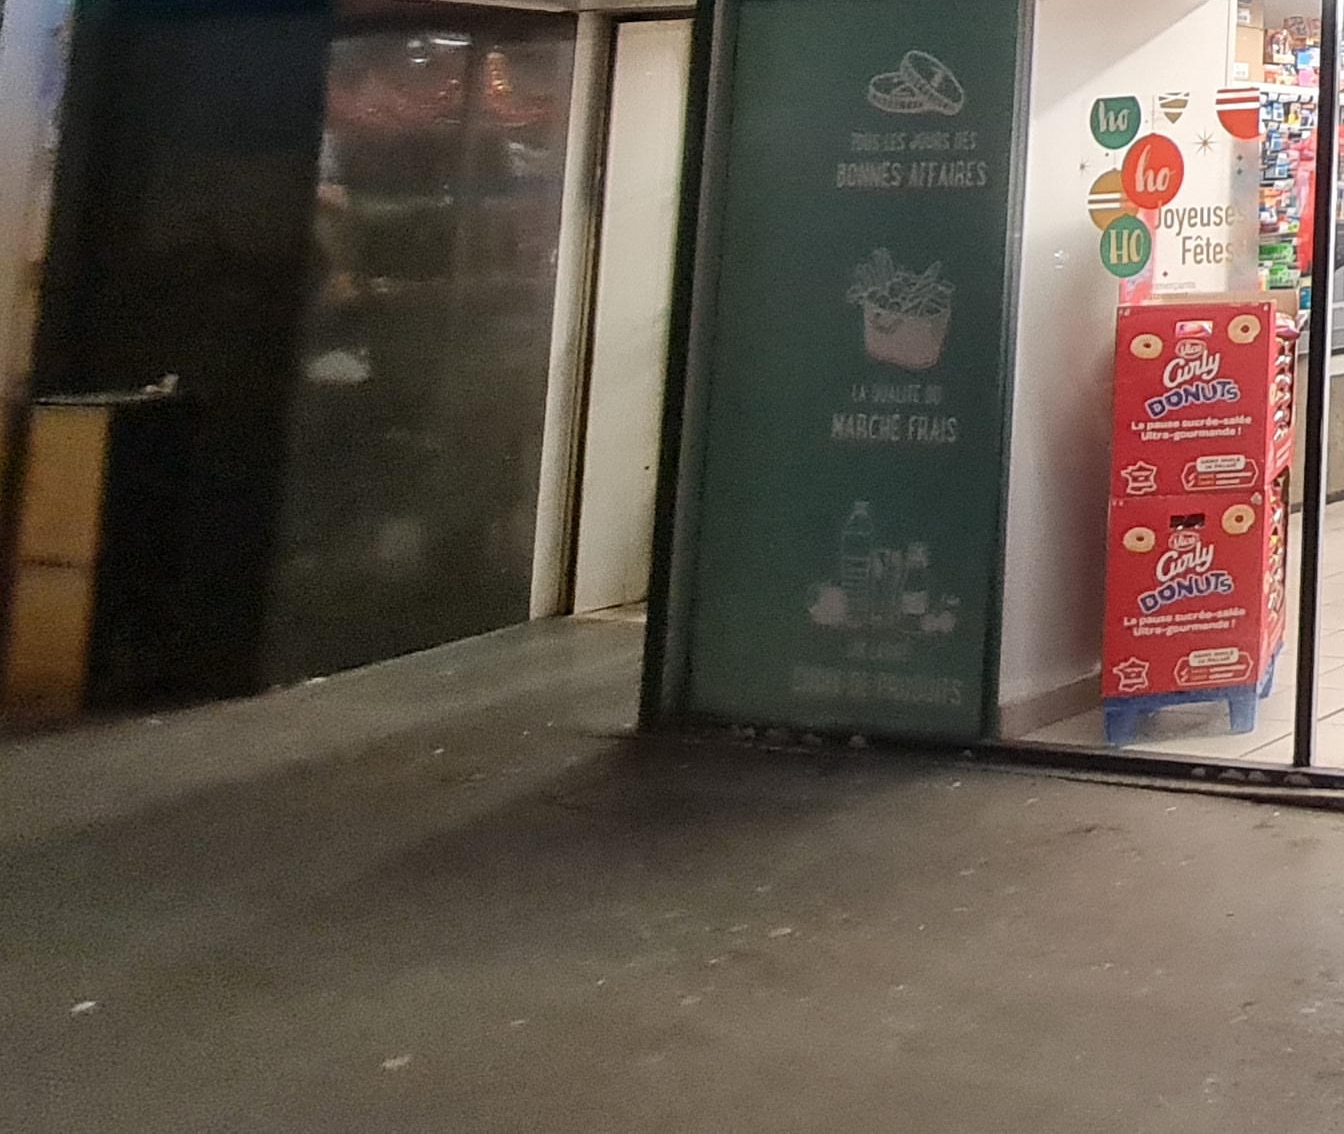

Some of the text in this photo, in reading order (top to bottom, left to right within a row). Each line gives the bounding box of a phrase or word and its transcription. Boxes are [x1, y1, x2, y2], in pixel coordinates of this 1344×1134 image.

[1098, 100, 1131, 133] ho
[836, 160, 988, 188] BONNES AFFAIRES
[1135, 144, 1176, 193] ho
[1109, 229, 1143, 265] HO
[1181, 236, 1234, 265] Fêtes
[1163, 349, 1220, 388] Curly
[1145, 378, 1240, 419] DONUTS
[907, 414, 958, 443] FRAIS
[1156, 543, 1214, 582] Curly
[1138, 570, 1233, 613] DONUTS
